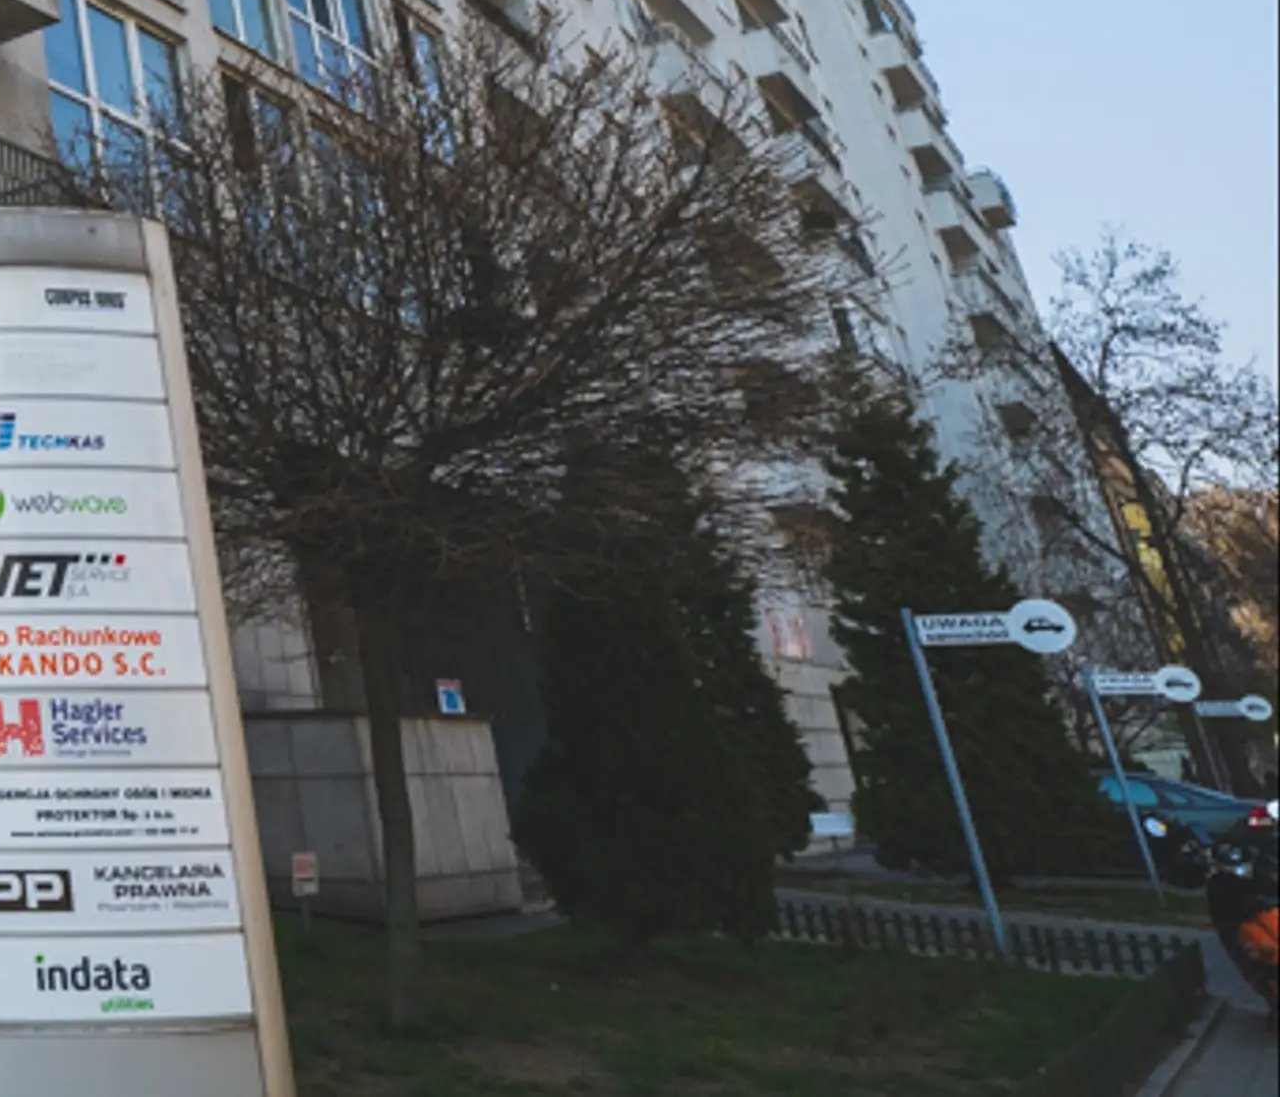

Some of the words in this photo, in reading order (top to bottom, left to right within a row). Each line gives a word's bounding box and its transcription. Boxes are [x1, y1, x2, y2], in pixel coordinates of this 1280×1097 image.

[18, 434, 105, 450] TECHKAS
[11, 491, 127, 515] webwave
[70, 567, 130, 582] SERVICE
[16, 626, 162, 647] Rachunkowe
[113, 652, 166, 676] S.C.
[50, 698, 124, 724] Hagler
[52, 723, 148, 745] Services
[36, 809, 117, 821] PROTEKTOR
[94, 864, 226, 882] KANCELARIA
[114, 882, 213, 899] PRAWNA
[35, 954, 151, 991] indata
